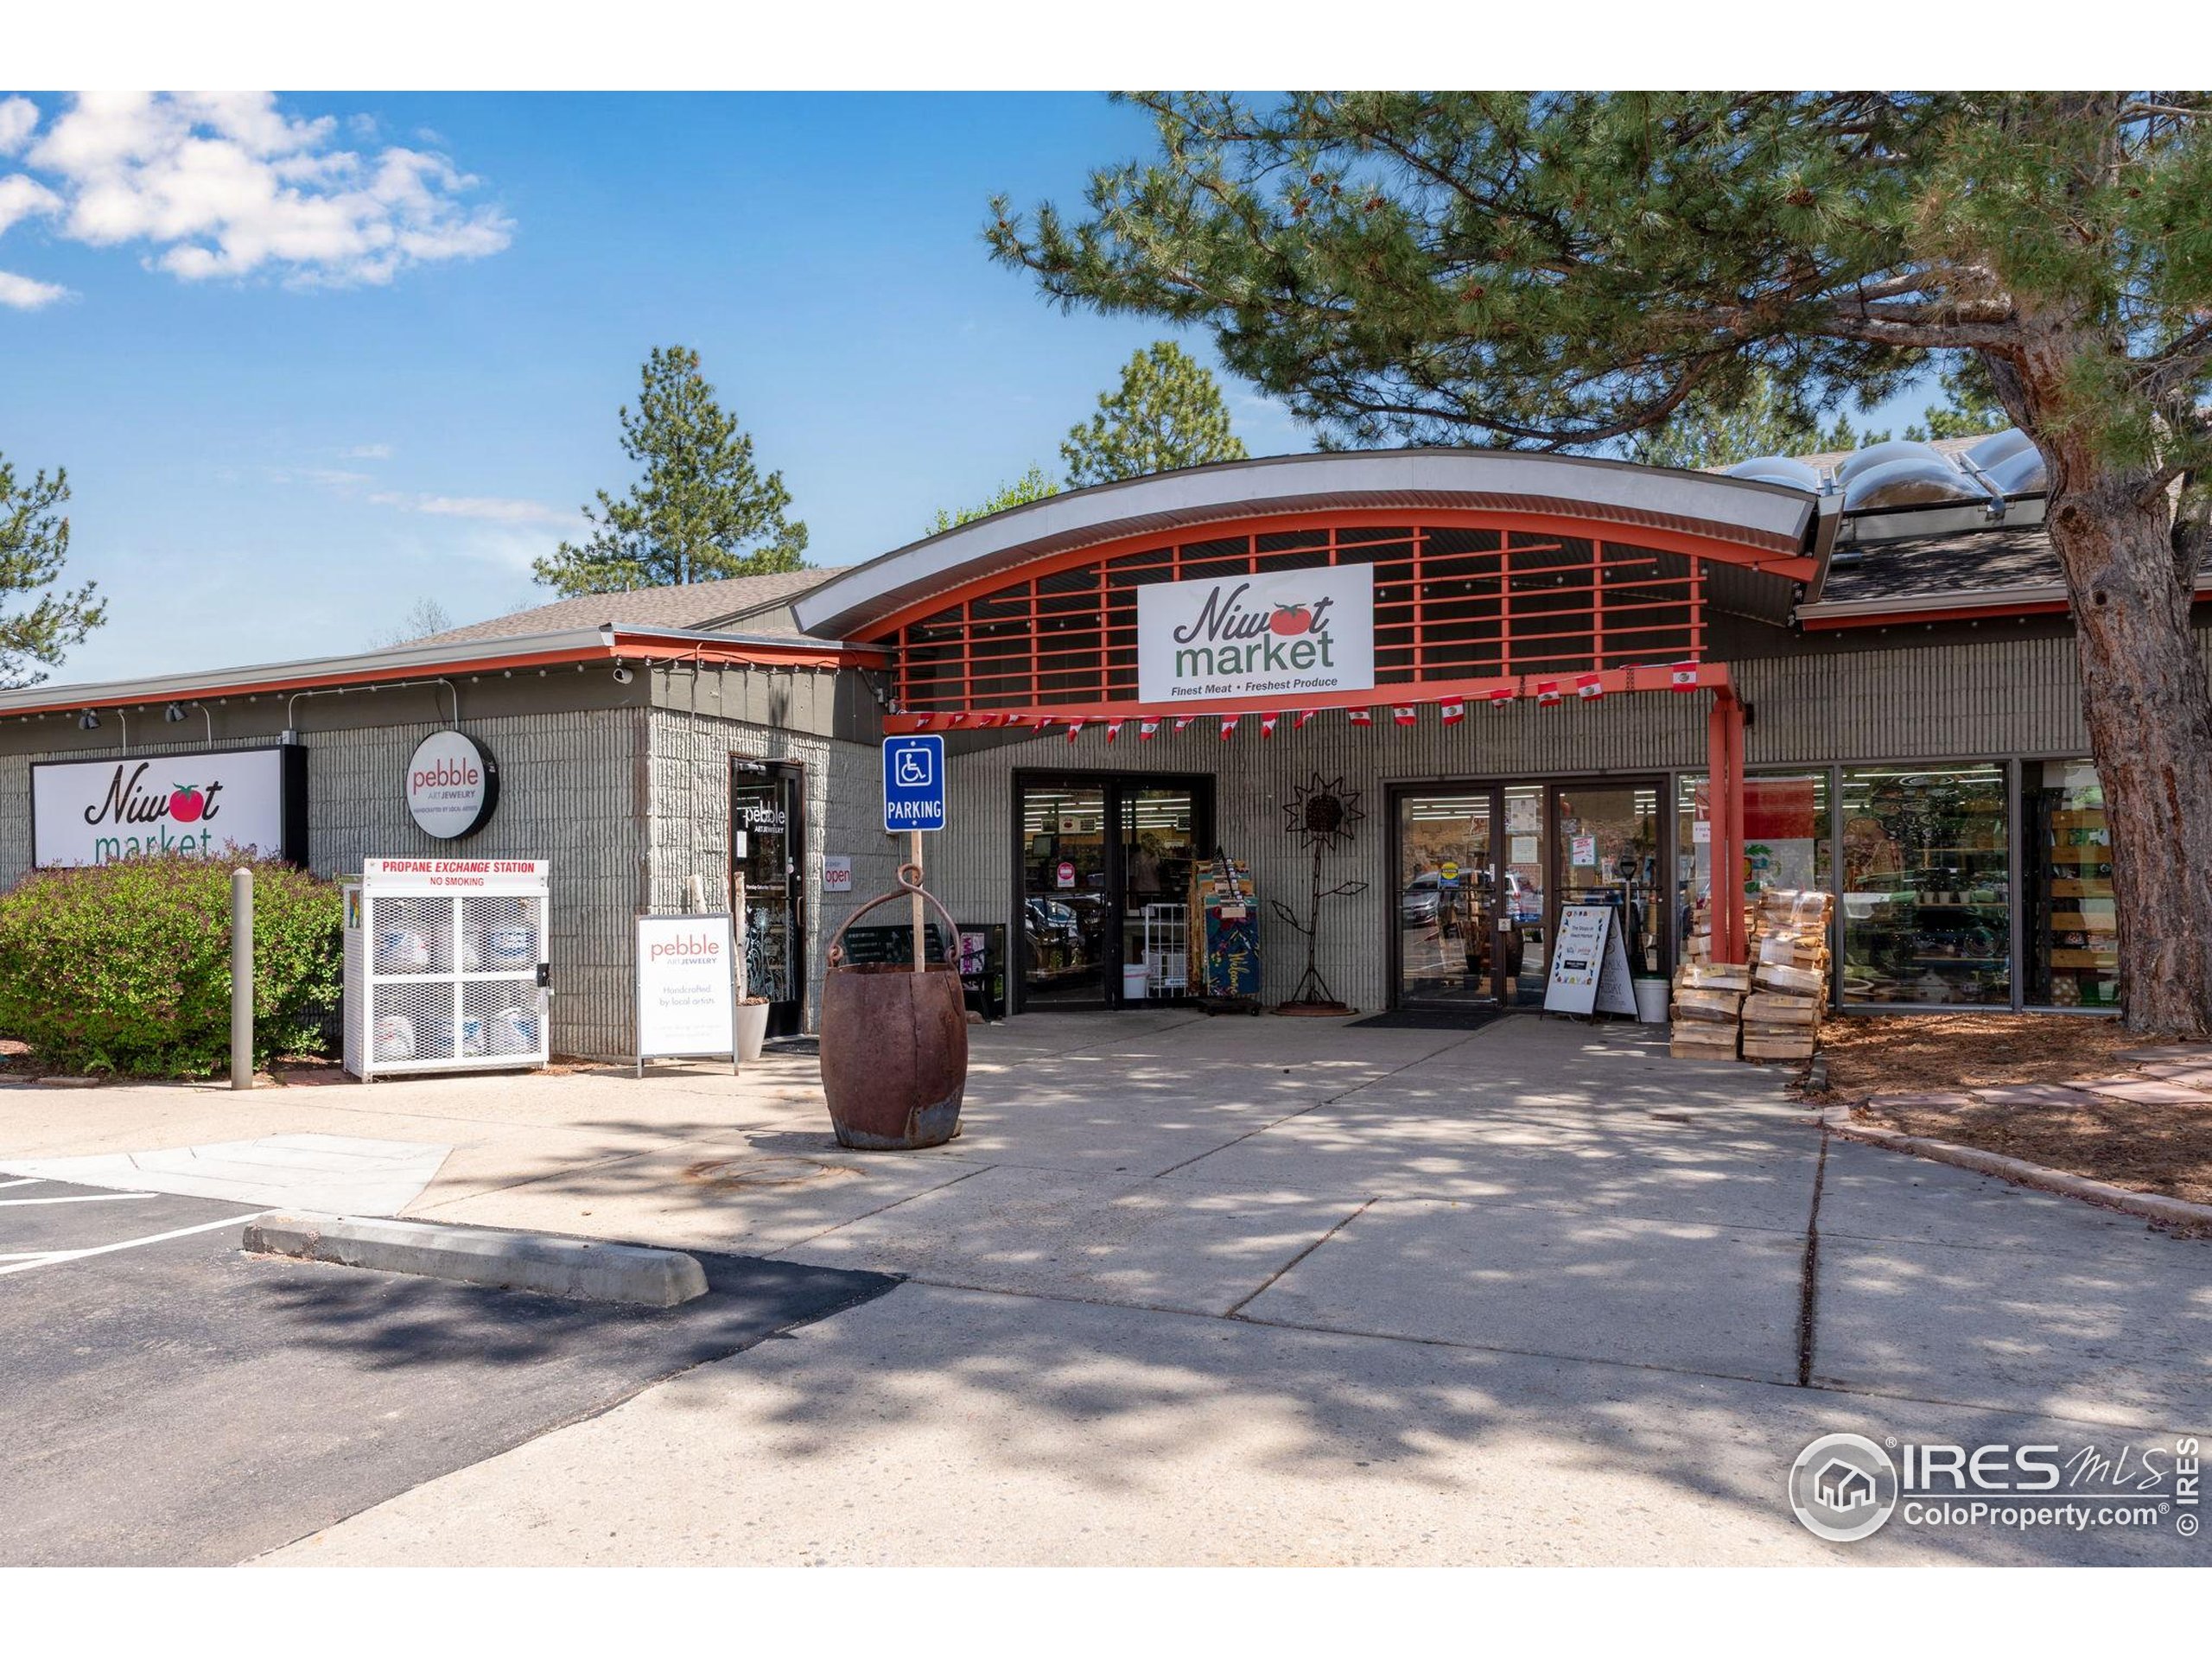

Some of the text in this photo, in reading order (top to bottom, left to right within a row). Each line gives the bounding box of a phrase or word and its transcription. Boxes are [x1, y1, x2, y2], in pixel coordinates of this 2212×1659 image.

[1173, 582, 1334, 644] Niwot
[1176, 630, 1334, 677] market
[1172, 677, 1338, 696] Finest Meat Freshest Produce
[413, 757, 479, 796] pebble
[85, 762, 223, 825] Niwot
[745, 799, 785, 829] pebble
[887, 801, 942, 819] PARKING
[383, 861, 535, 873] PROPANE EXCHANGE STATION
[825, 869, 850, 889] open
[430, 877, 485, 887] NO SMOKING
[652, 933, 720, 962] pebble
